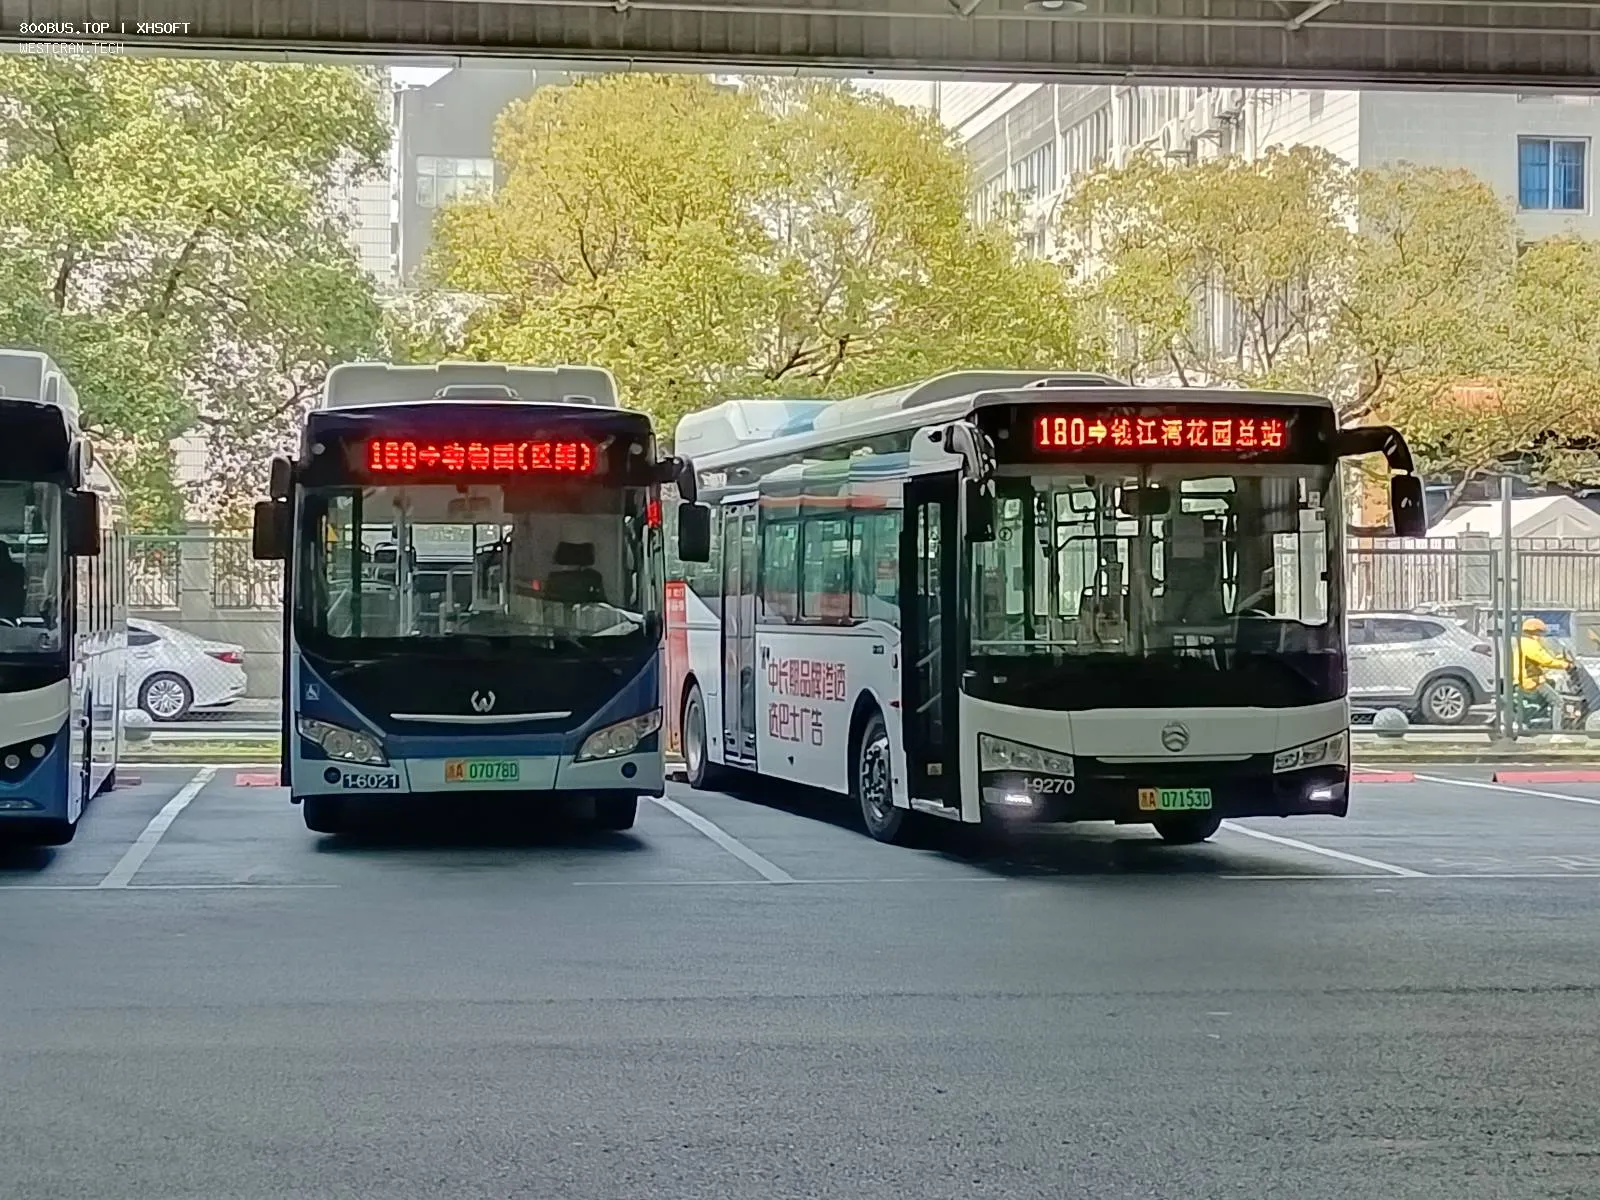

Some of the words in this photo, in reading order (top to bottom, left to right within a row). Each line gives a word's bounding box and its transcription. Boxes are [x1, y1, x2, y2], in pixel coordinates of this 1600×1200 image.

[1039, 417, 1085, 446] 180
[343, 774, 399, 789] 1-6021
[1022, 777, 1076, 795] 1-9270
